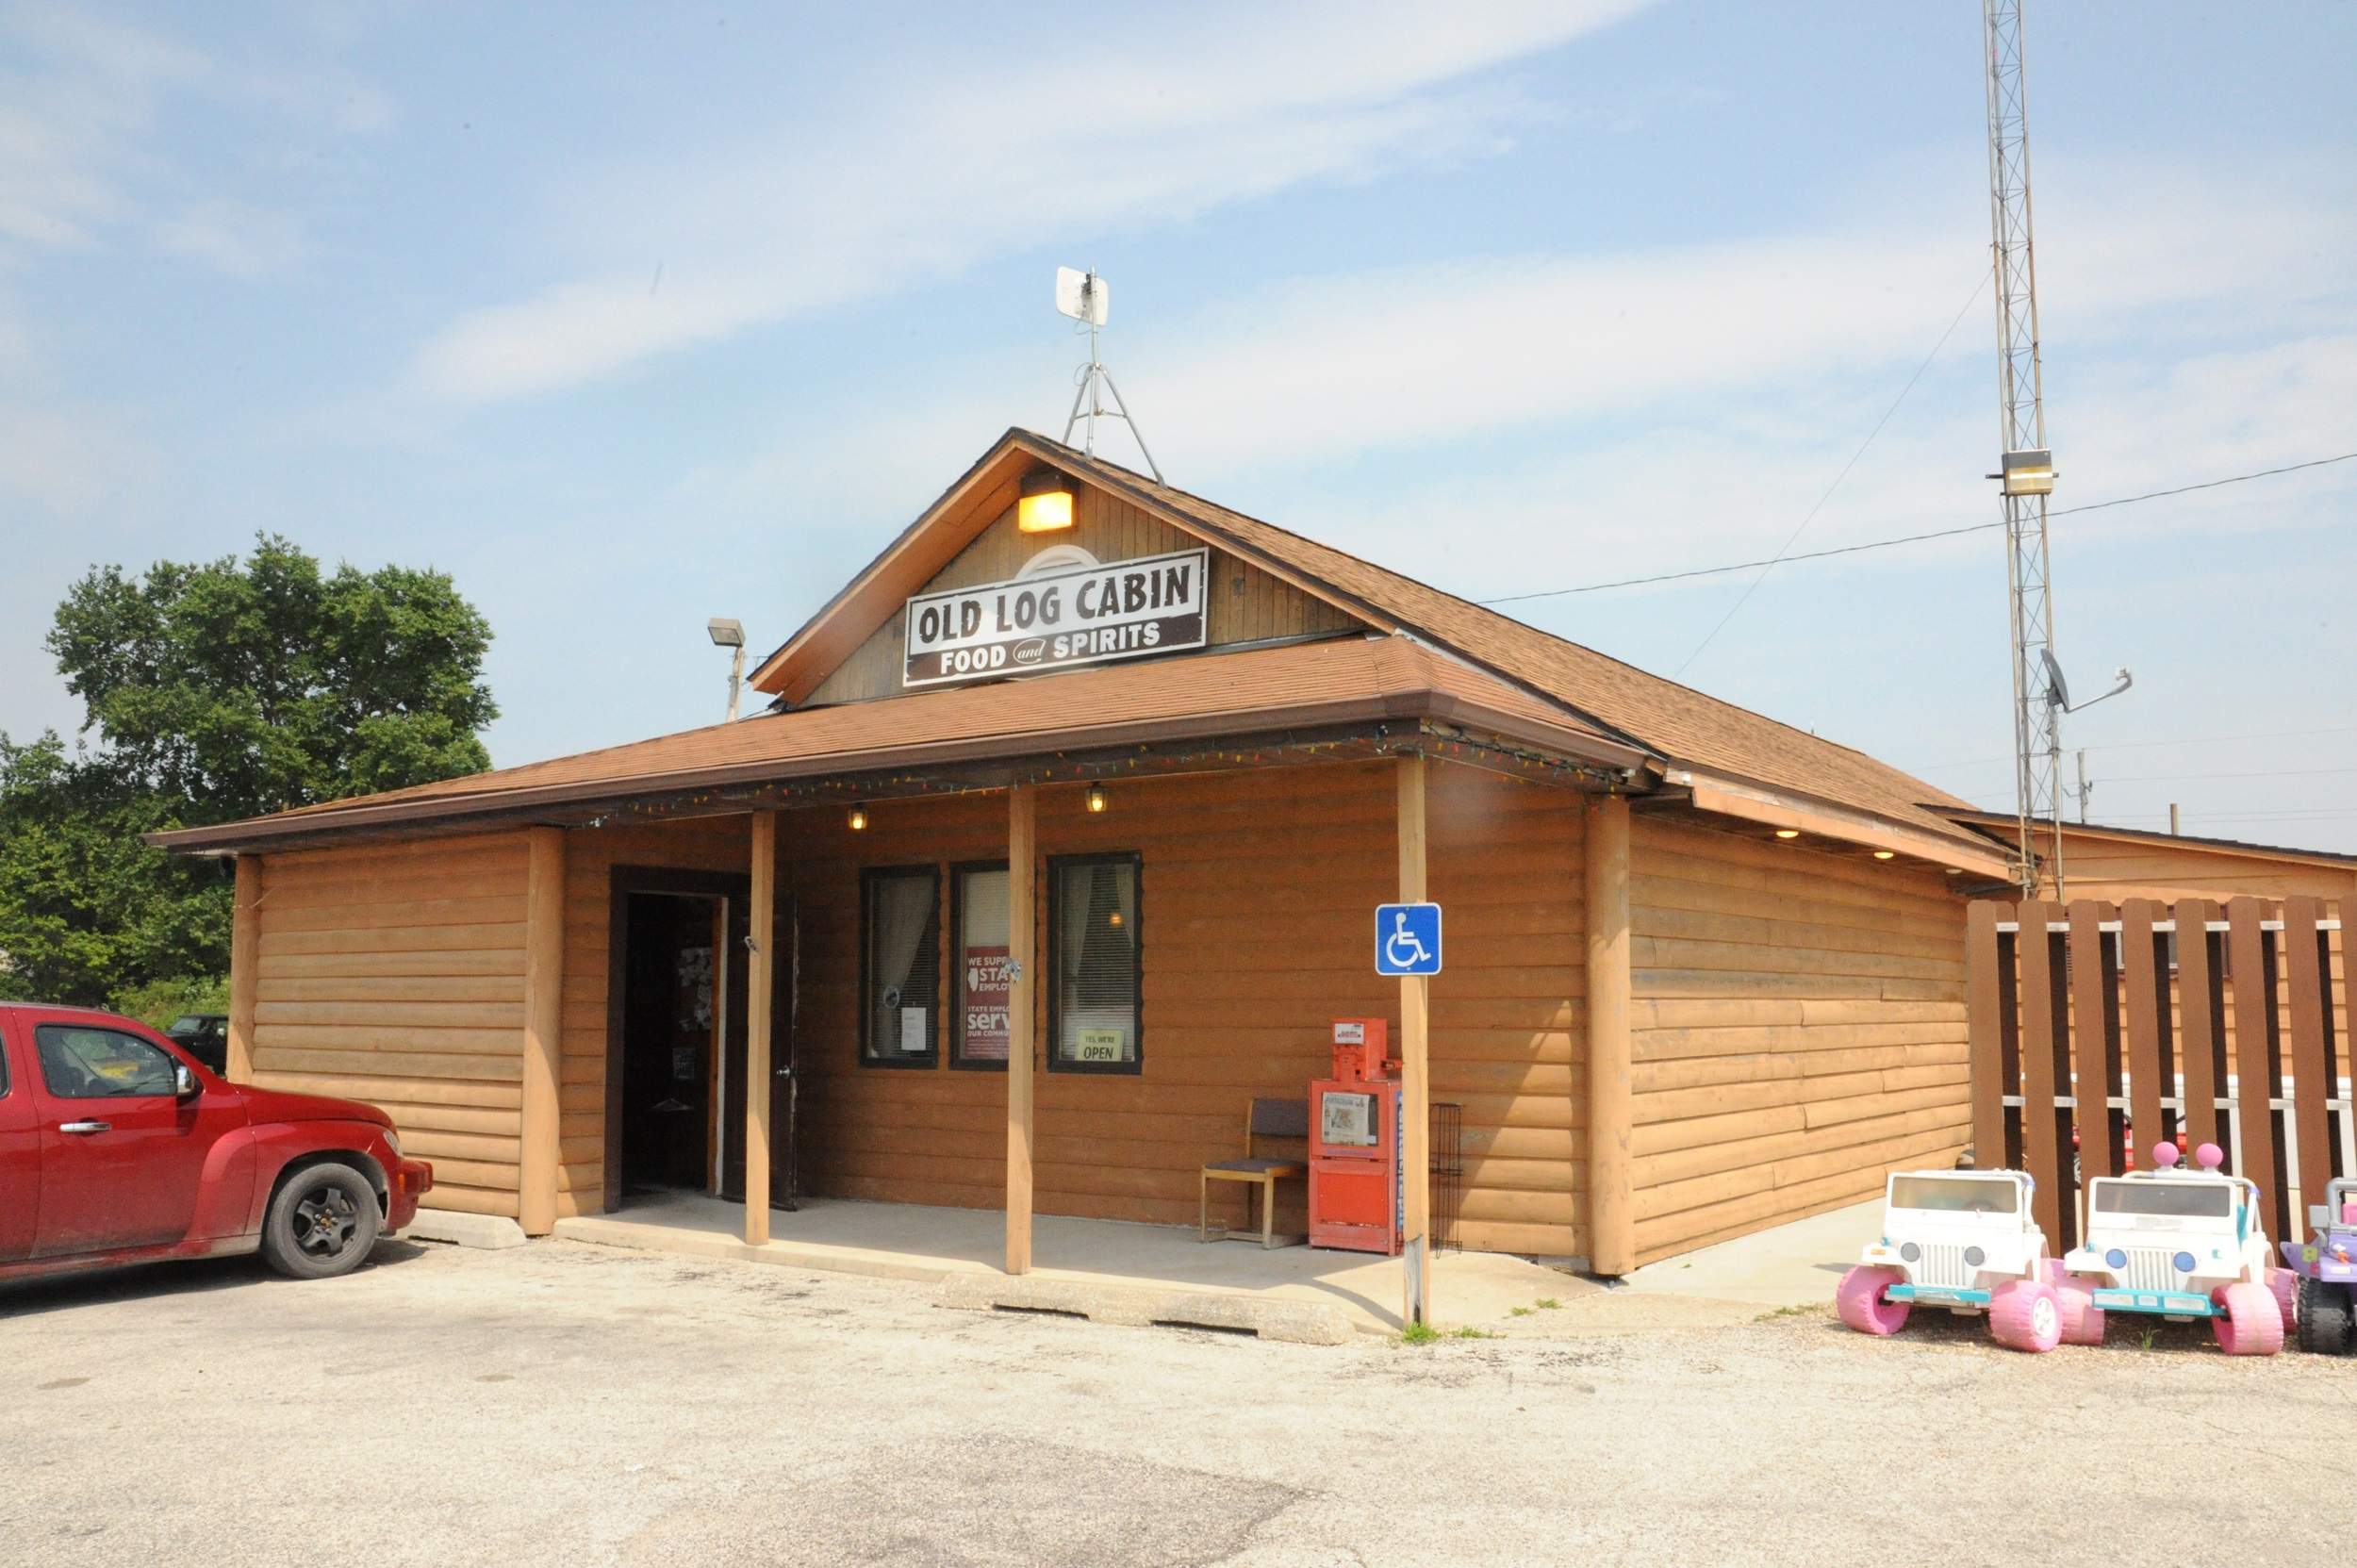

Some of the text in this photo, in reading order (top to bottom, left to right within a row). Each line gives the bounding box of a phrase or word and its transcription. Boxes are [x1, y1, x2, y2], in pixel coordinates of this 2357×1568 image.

[919, 565, 1190, 644] OLD LOG CABIN
[941, 621, 1160, 674] FOOD and SPIRITS
[967, 956, 1007, 966] WE SUPP
[980, 967, 1009, 982] STA
[980, 982, 1010, 992] EMPLO
[967, 1013, 1010, 1030] serv
[1083, 1047, 1113, 1060] OPEN
